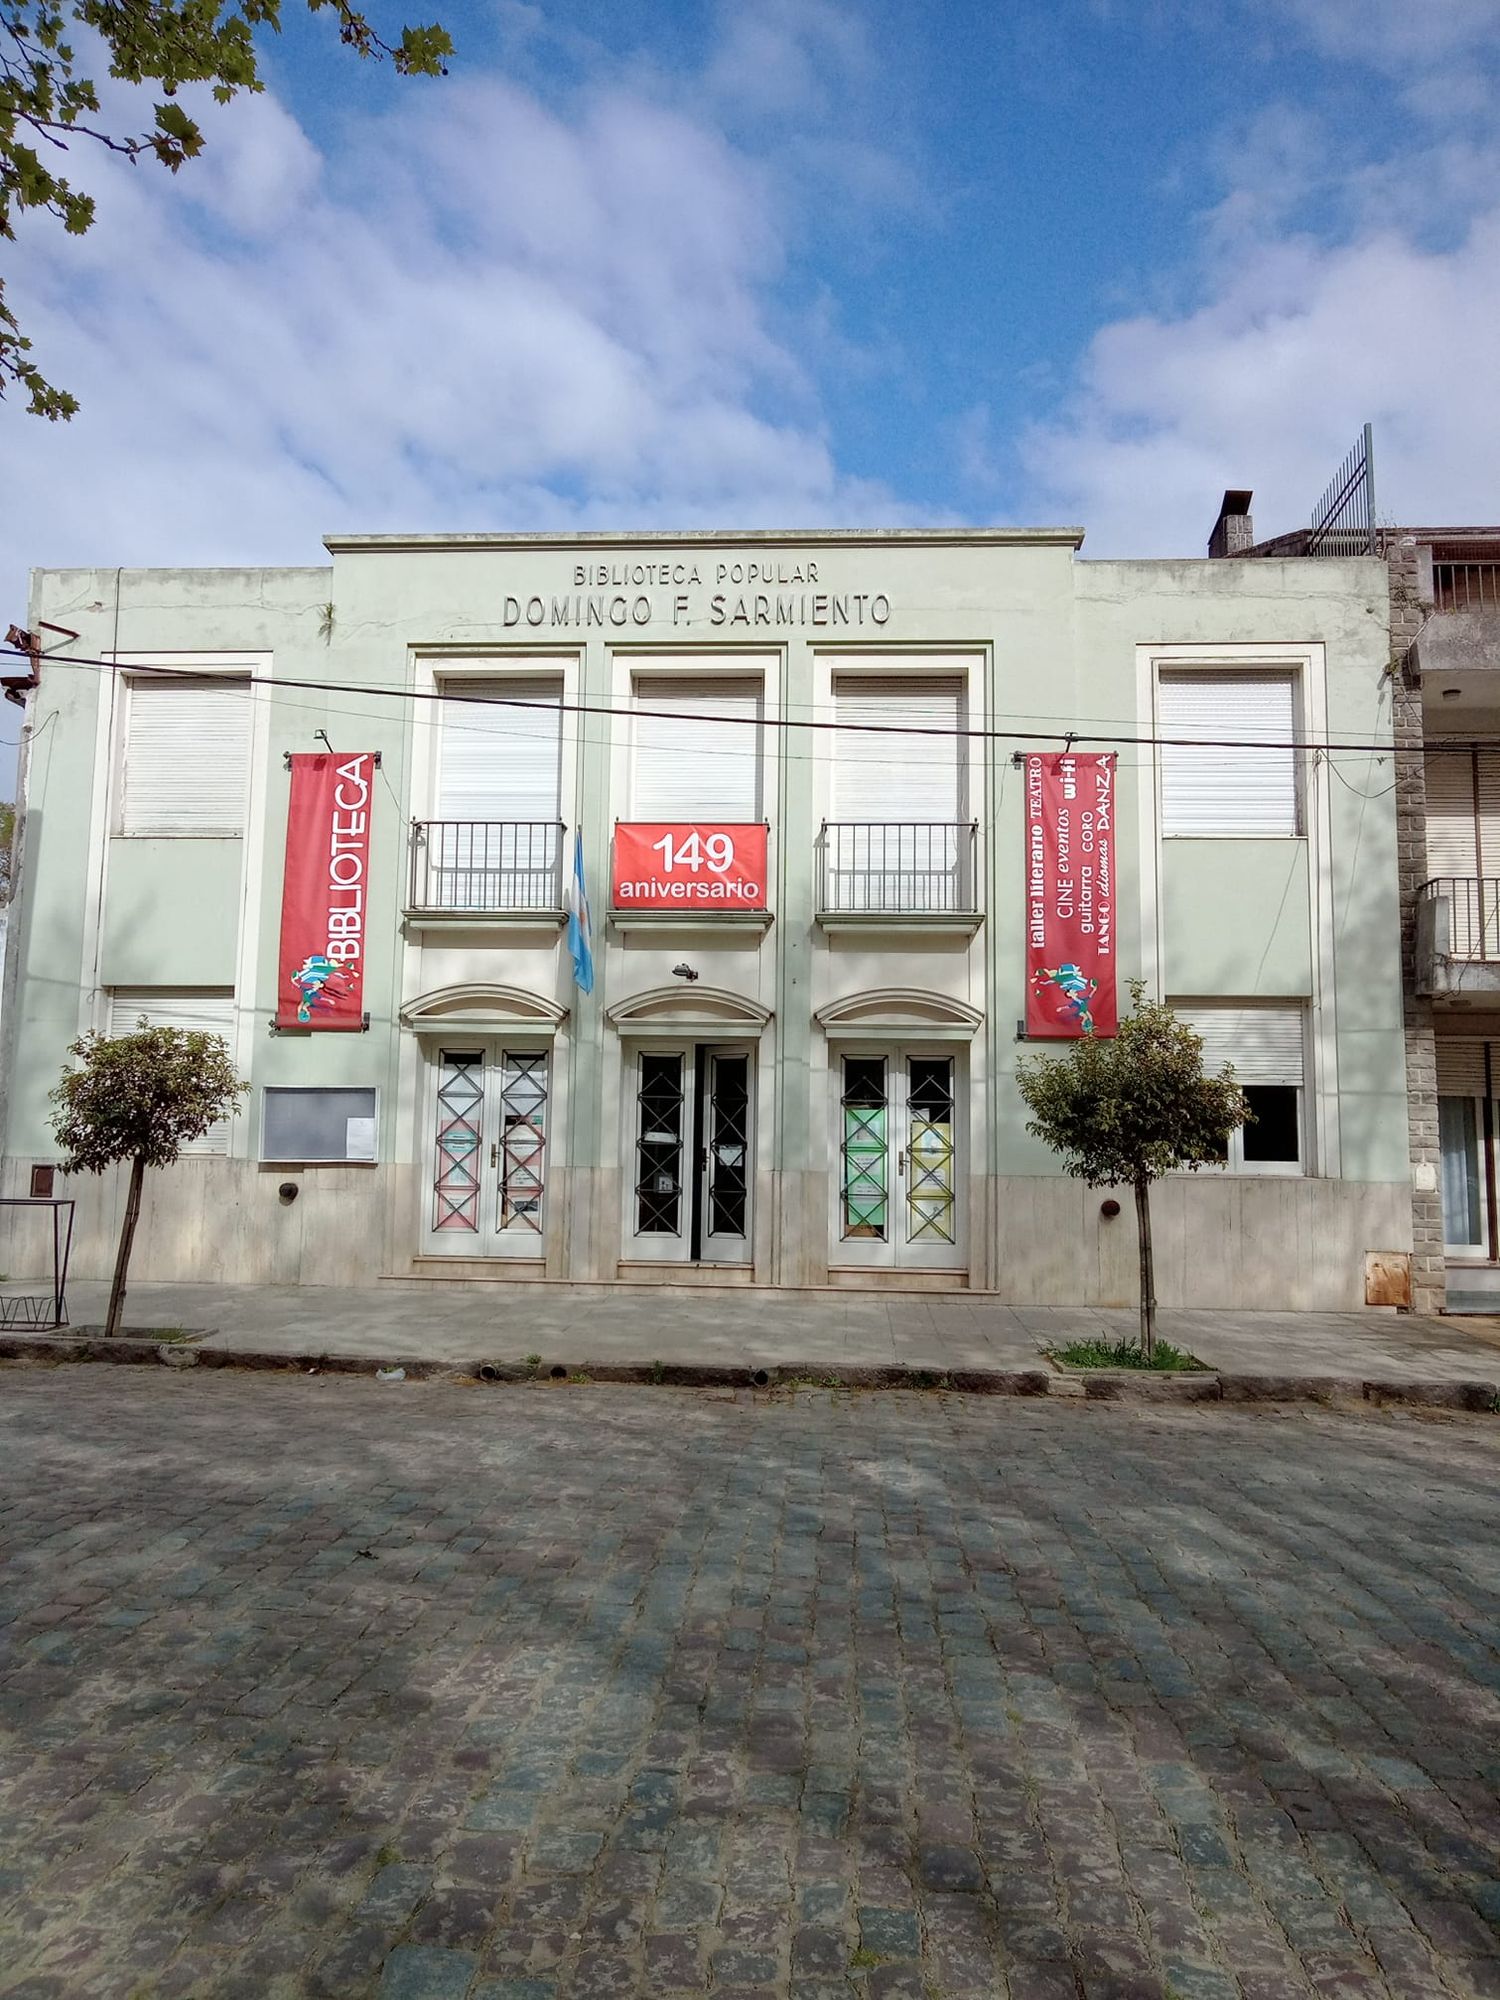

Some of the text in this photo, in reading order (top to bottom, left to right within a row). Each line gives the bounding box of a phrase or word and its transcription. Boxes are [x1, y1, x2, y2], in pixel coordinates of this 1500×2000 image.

[503, 594, 891, 626] DOMINGO F. SARMIENTO
[574, 563, 819, 586] BIBLIOTECA POPULAR
[326, 754, 368, 961] BIBLIOTECA
[619, 877, 759, 898] aniversario
[652, 832, 734, 873] 149
[1029, 757, 1045, 948] taller literario TEATRO
[1057, 758, 1076, 918] CINE eventos wi-fi
[1078, 811, 1094, 934] guitarra CORO
[1095, 755, 1111, 956] TANGO idiomas DANZA
